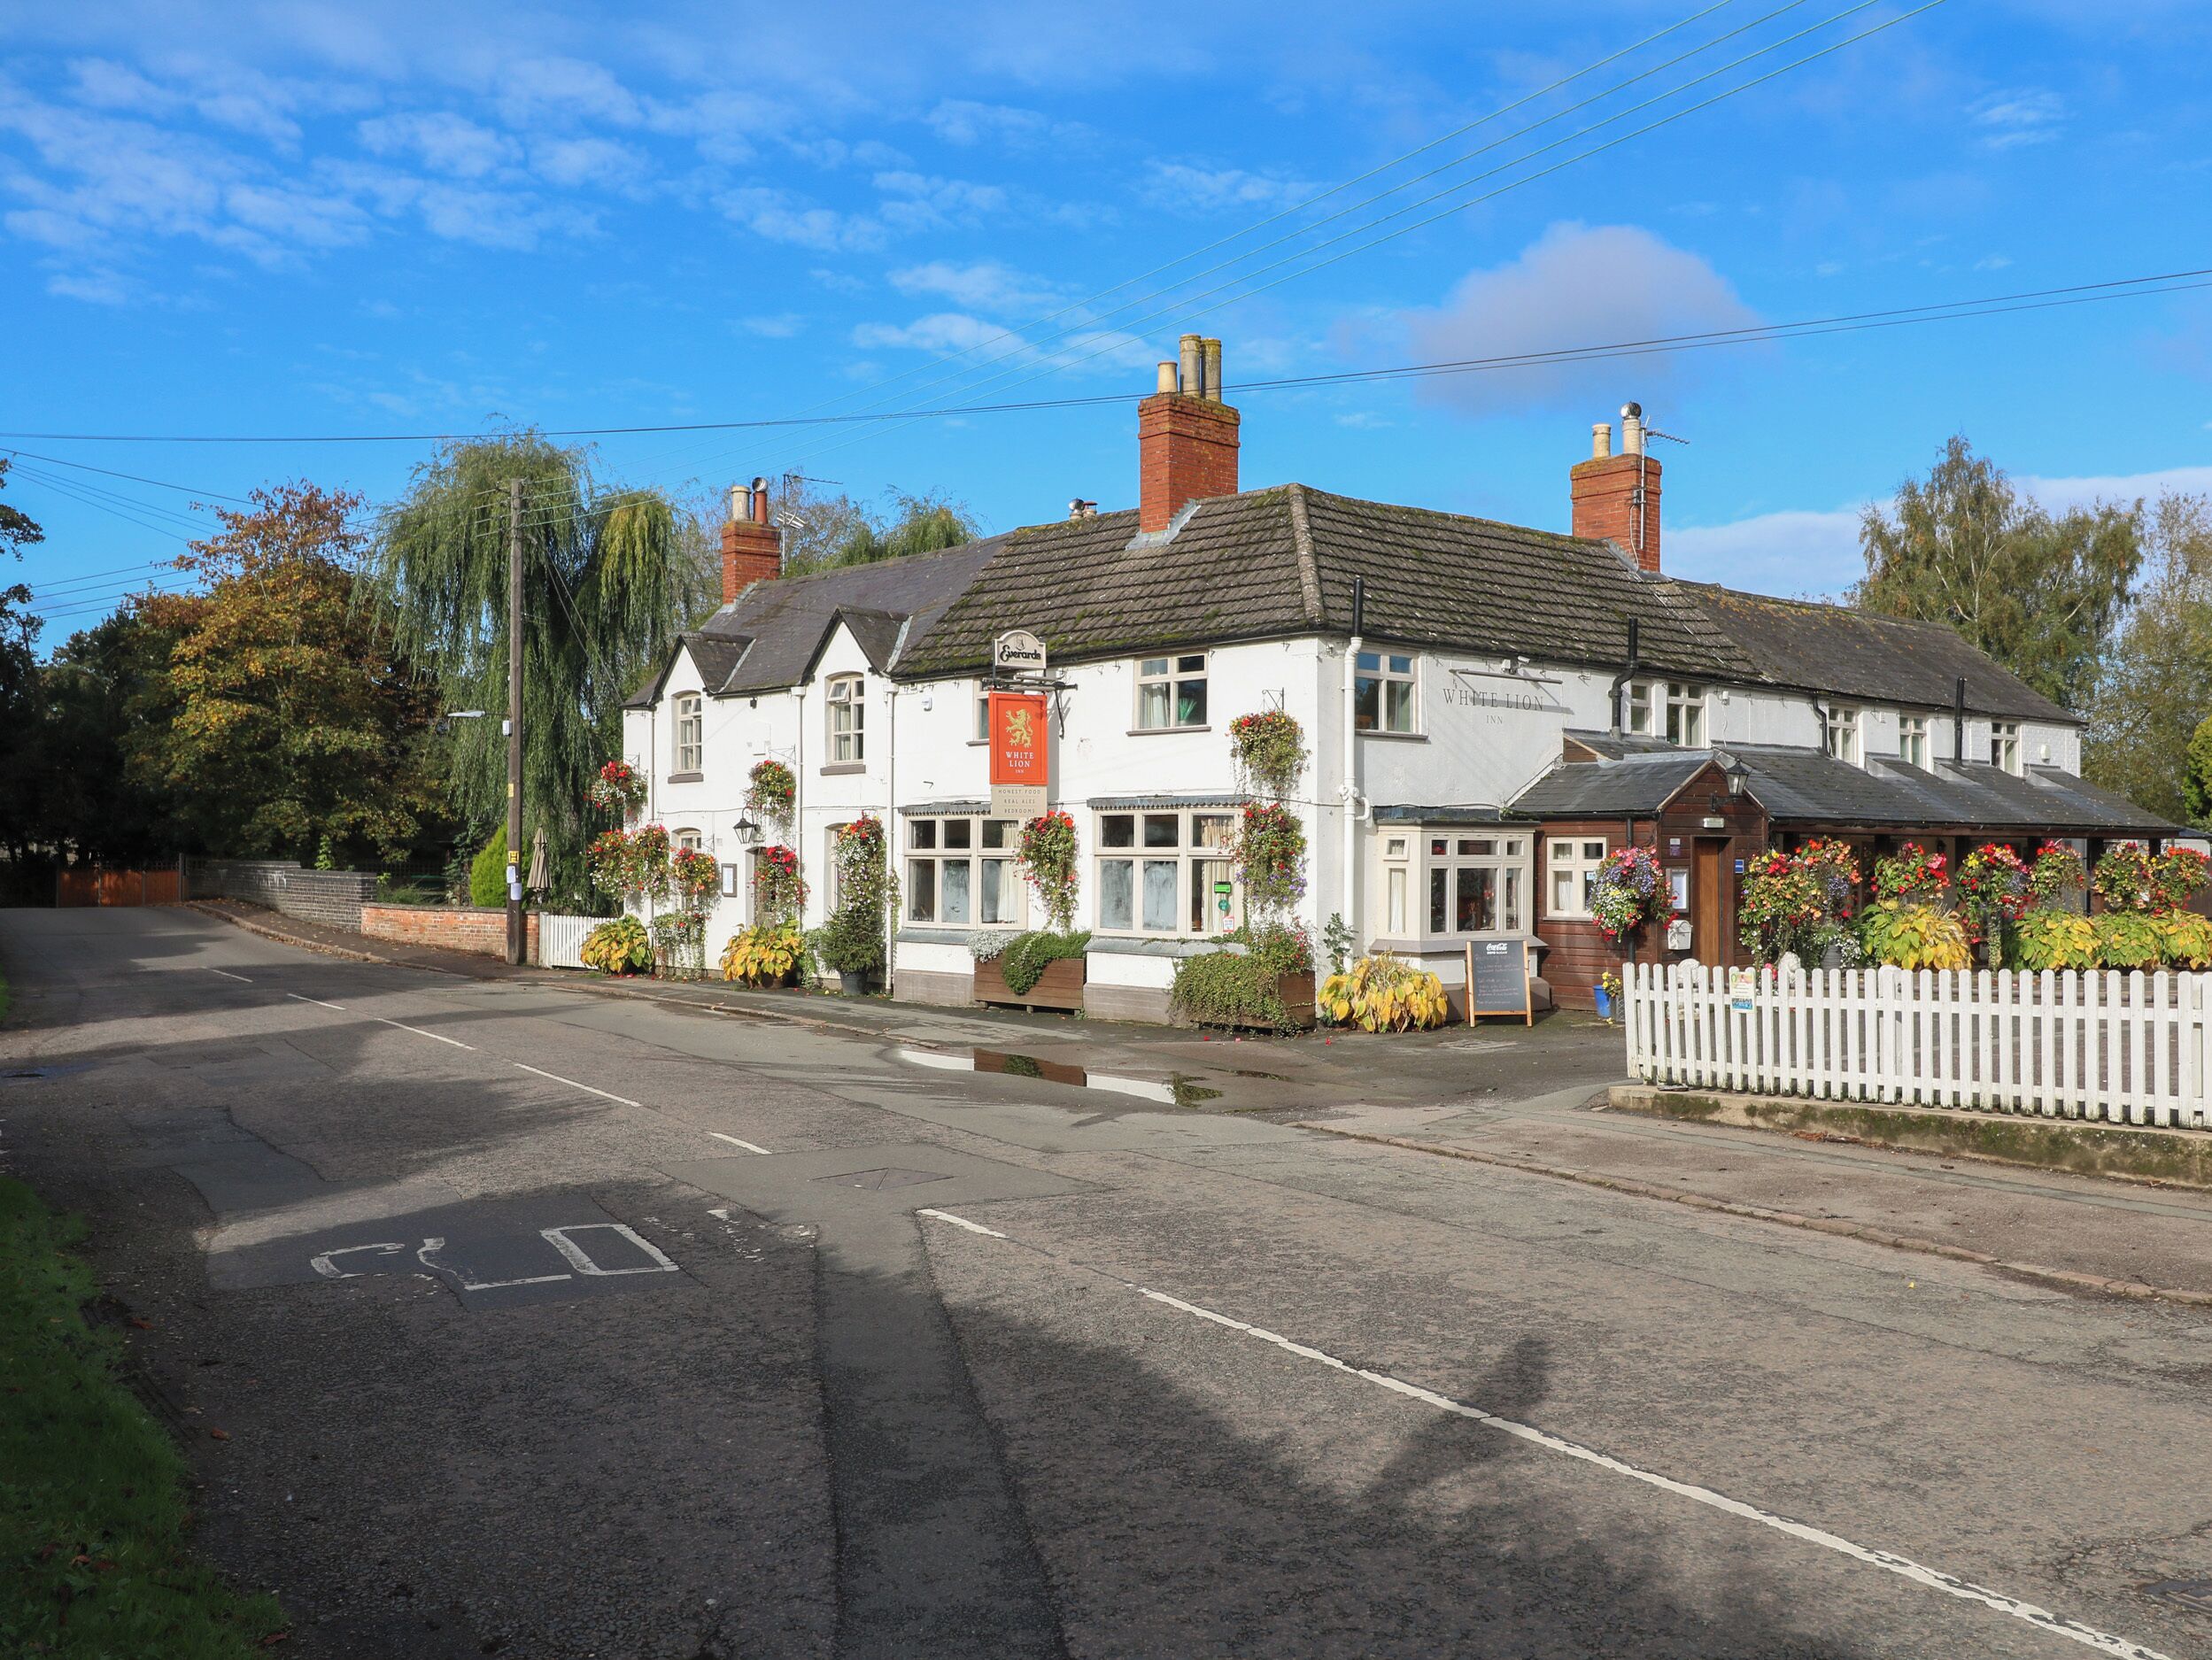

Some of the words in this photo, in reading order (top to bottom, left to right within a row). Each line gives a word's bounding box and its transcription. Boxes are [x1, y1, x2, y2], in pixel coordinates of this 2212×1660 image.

[1000, 645, 1041, 661] Everards
[1442, 689, 1498, 708] WHITE
[1505, 693, 1544, 711] LION
[1486, 714, 1504, 724] INN
[1005, 751, 1034, 760] WHITE
[1009, 760, 1031, 768] LION
